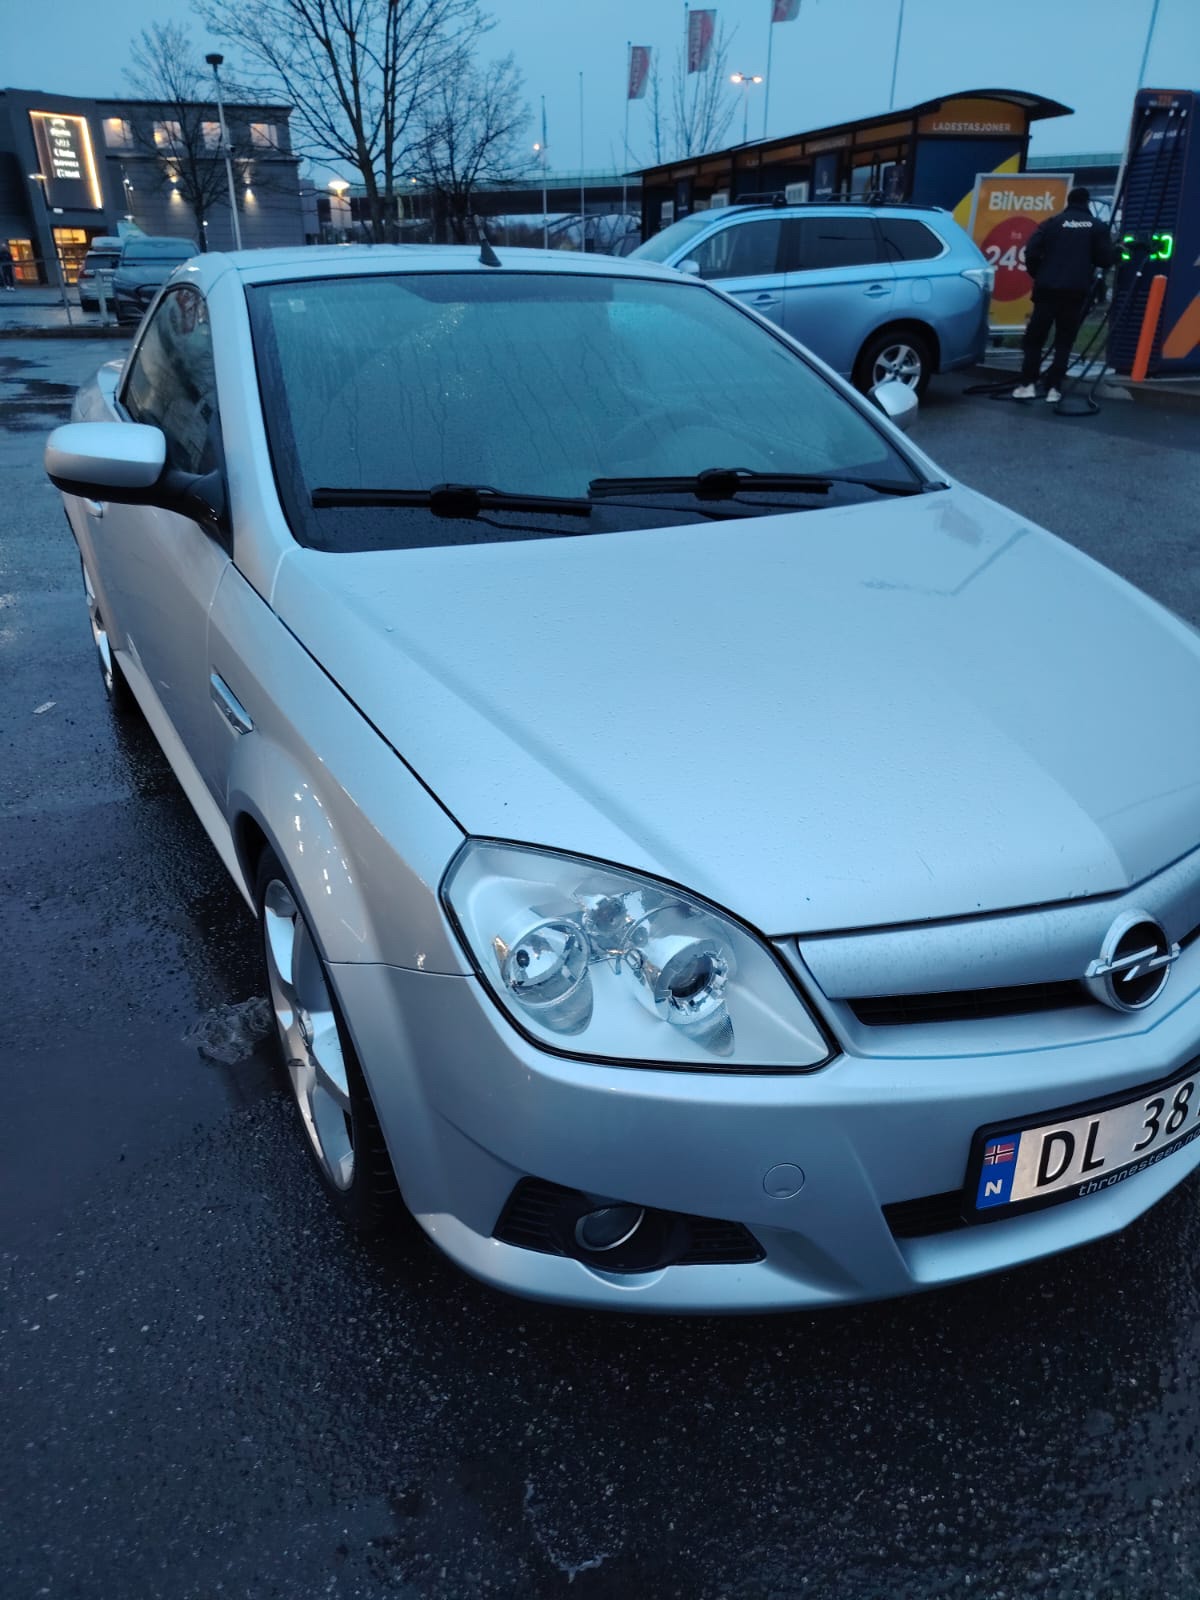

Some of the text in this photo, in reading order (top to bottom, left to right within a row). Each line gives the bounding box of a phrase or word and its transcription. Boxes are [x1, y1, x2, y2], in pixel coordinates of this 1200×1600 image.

[932, 121, 1011, 132] LADESTASJONER
[988, 191, 1056, 210] Bilvask
[1062, 220, 1093, 228] Adecco
[1035, 1081, 1200, 1188] DL 38
[1079, 1129, 1200, 1197] thranesteen.no
[984, 1178, 1003, 1197] N
